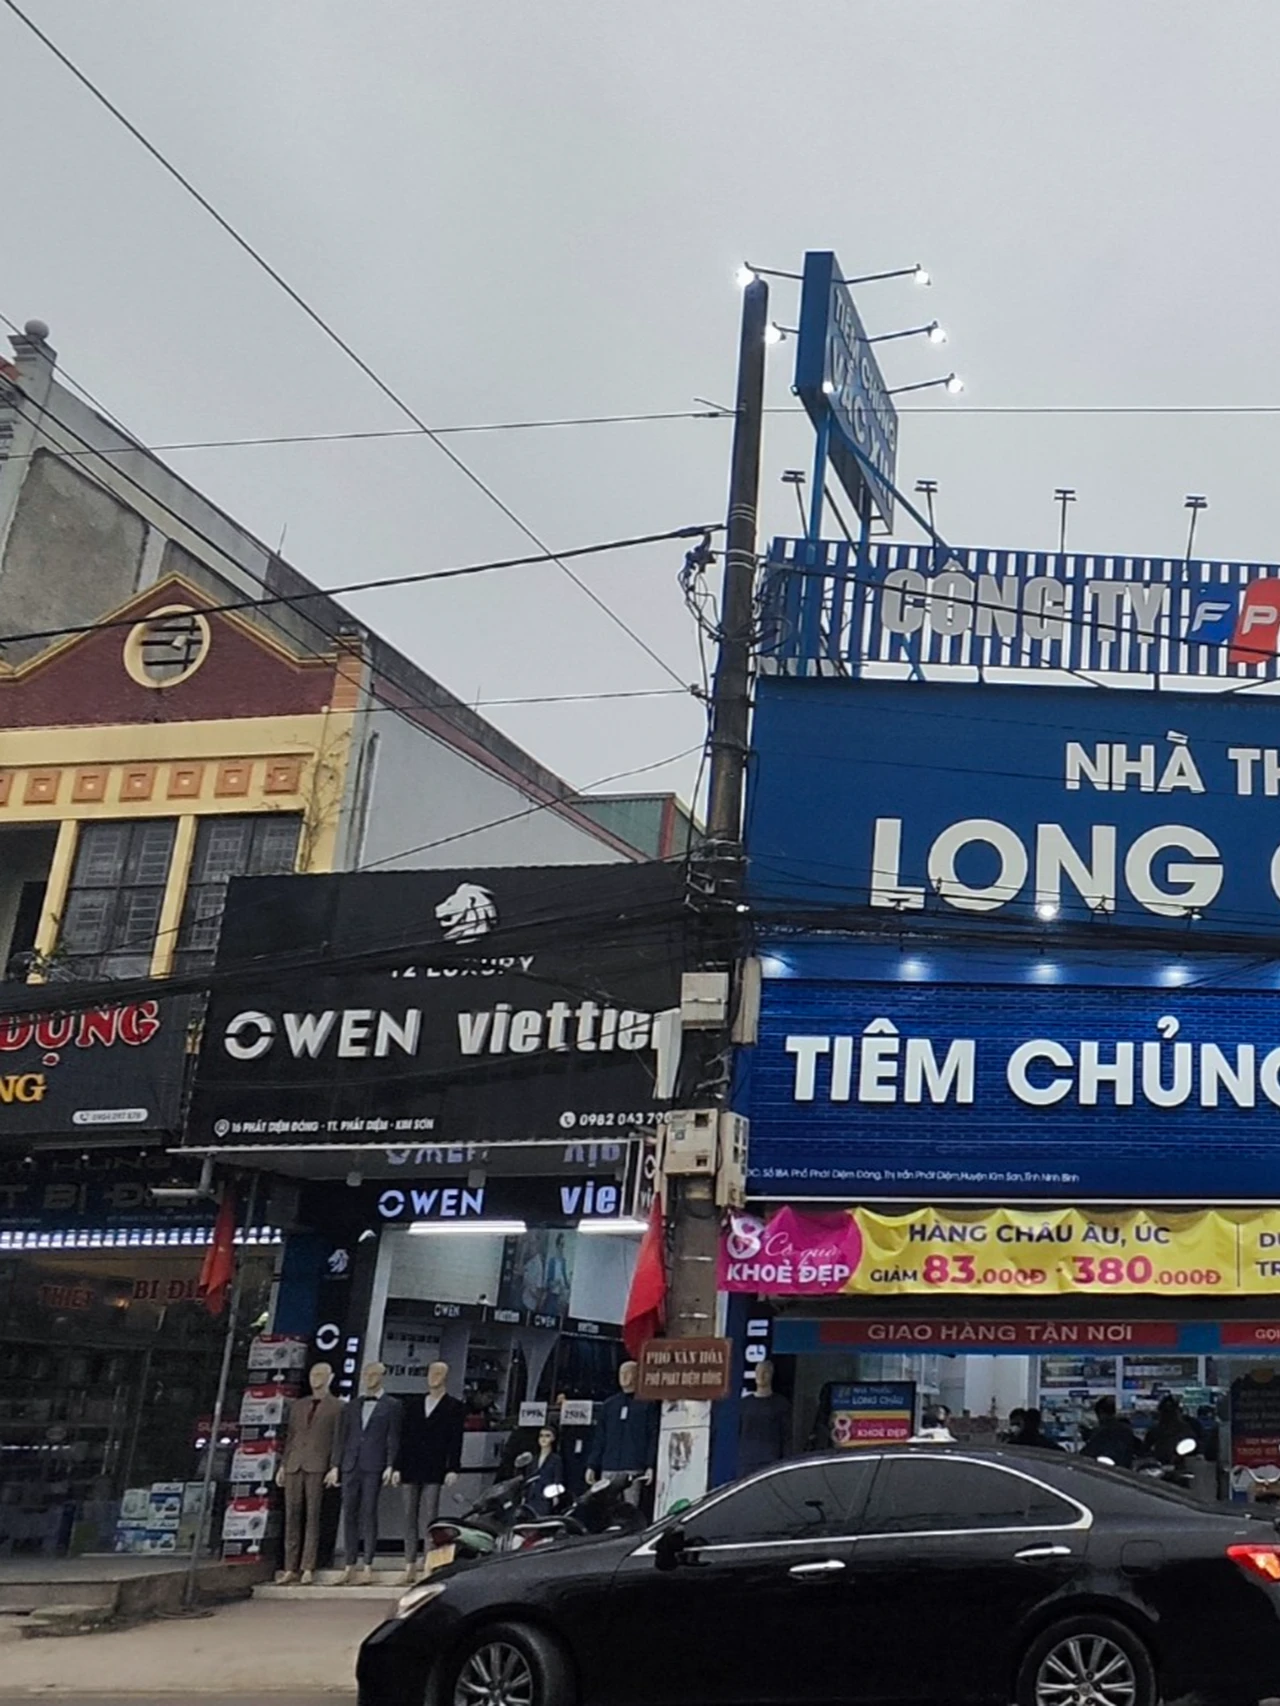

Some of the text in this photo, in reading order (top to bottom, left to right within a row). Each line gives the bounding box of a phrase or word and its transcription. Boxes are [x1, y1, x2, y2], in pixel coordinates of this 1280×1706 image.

[881, 556, 1064, 641] CÔNG
[1088, 579, 1168, 645] TY
[1065, 730, 1206, 793] NHÀ
[869, 817, 1225, 918] LONG
[223, 1007, 422, 1060] OWEN
[786, 1017, 976, 1104] TIÊM
[579, 1112, 615, 1126] 0982
[377, 1188, 485, 1218] OWEN
[909, 1220, 1171, 1248] HÀNG CHÂU ÂU, ÚC
[798, 1262, 851, 1288] ĐẸP
[870, 1264, 918, 1283] GIẢM
[867, 1320, 1134, 1344] GIAO HÀNG TẬN NƠI
[1254, 1328, 1280, 1341] GỌI
